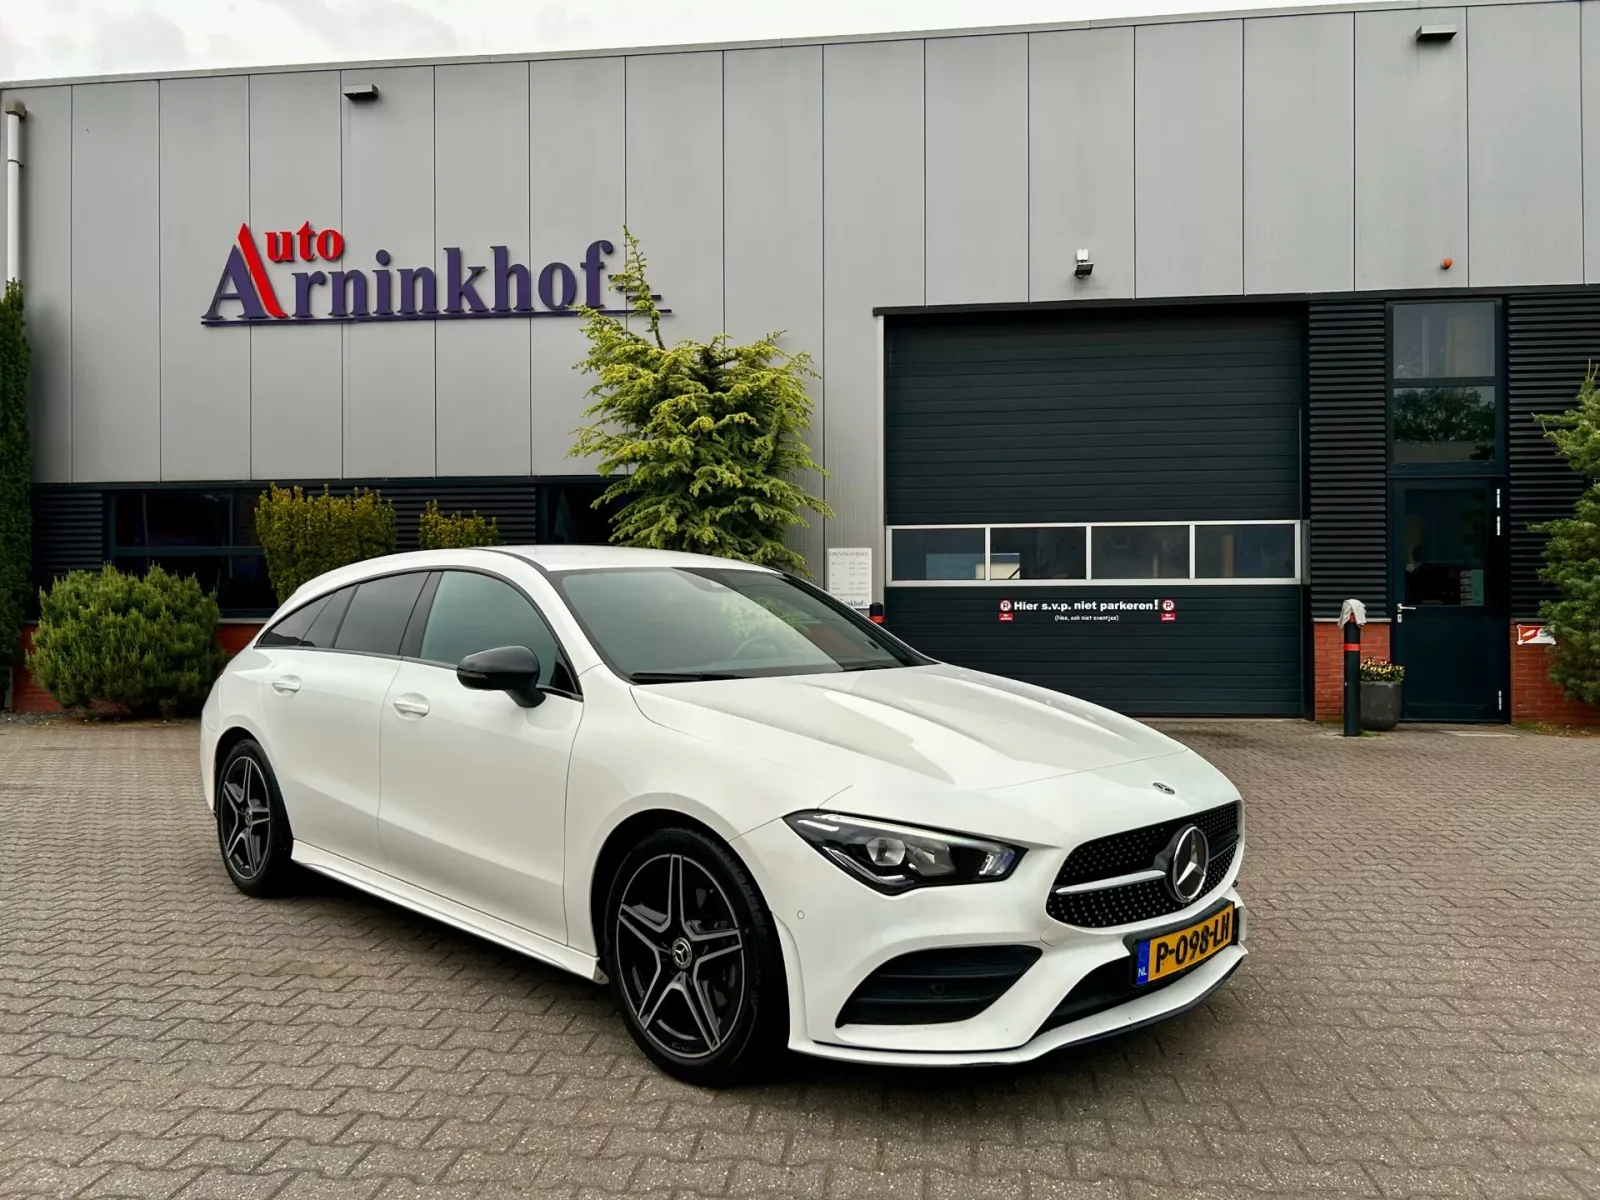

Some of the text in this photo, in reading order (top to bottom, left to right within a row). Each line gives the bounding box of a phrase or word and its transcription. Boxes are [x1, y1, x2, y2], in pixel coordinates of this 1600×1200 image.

[201, 239, 613, 319] Arninkhof
[1013, 599, 1159, 612] Hier s.v.p. niet parkeren!
[1155, 911, 1231, 974] P-098-LH
[1138, 966, 1148, 977] NL
